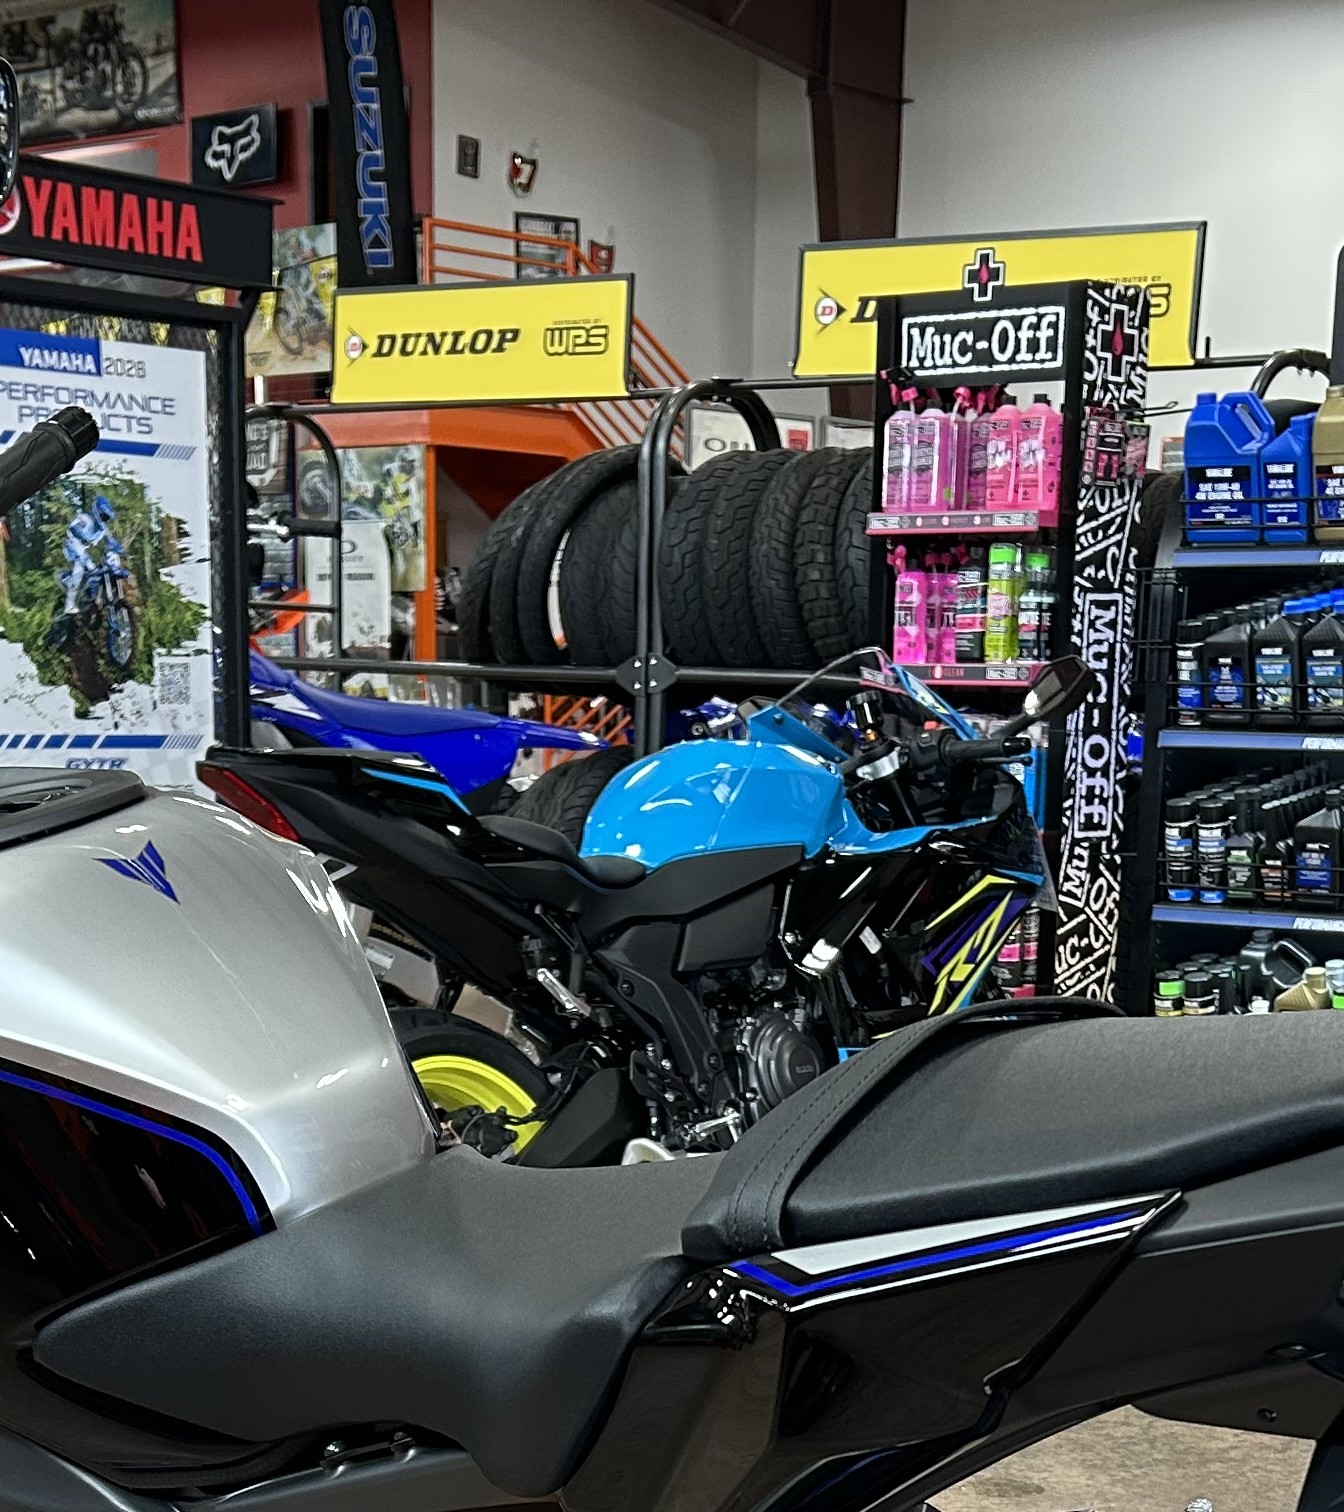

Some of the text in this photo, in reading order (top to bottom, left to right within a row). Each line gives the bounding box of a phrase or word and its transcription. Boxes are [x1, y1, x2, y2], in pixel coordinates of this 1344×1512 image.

[344, 6, 394, 268] SUZUKI
[22, 175, 203, 263] YAMAHA
[19, 346, 97, 374] YAMAHA
[371, 328, 521, 358] DUNLOP
[543, 325, 609, 357] WPS
[908, 315, 1058, 369] Muc-Off
[17, 405, 154, 435] PRUCTS
[1079, 604, 1116, 825] Muc-Off
